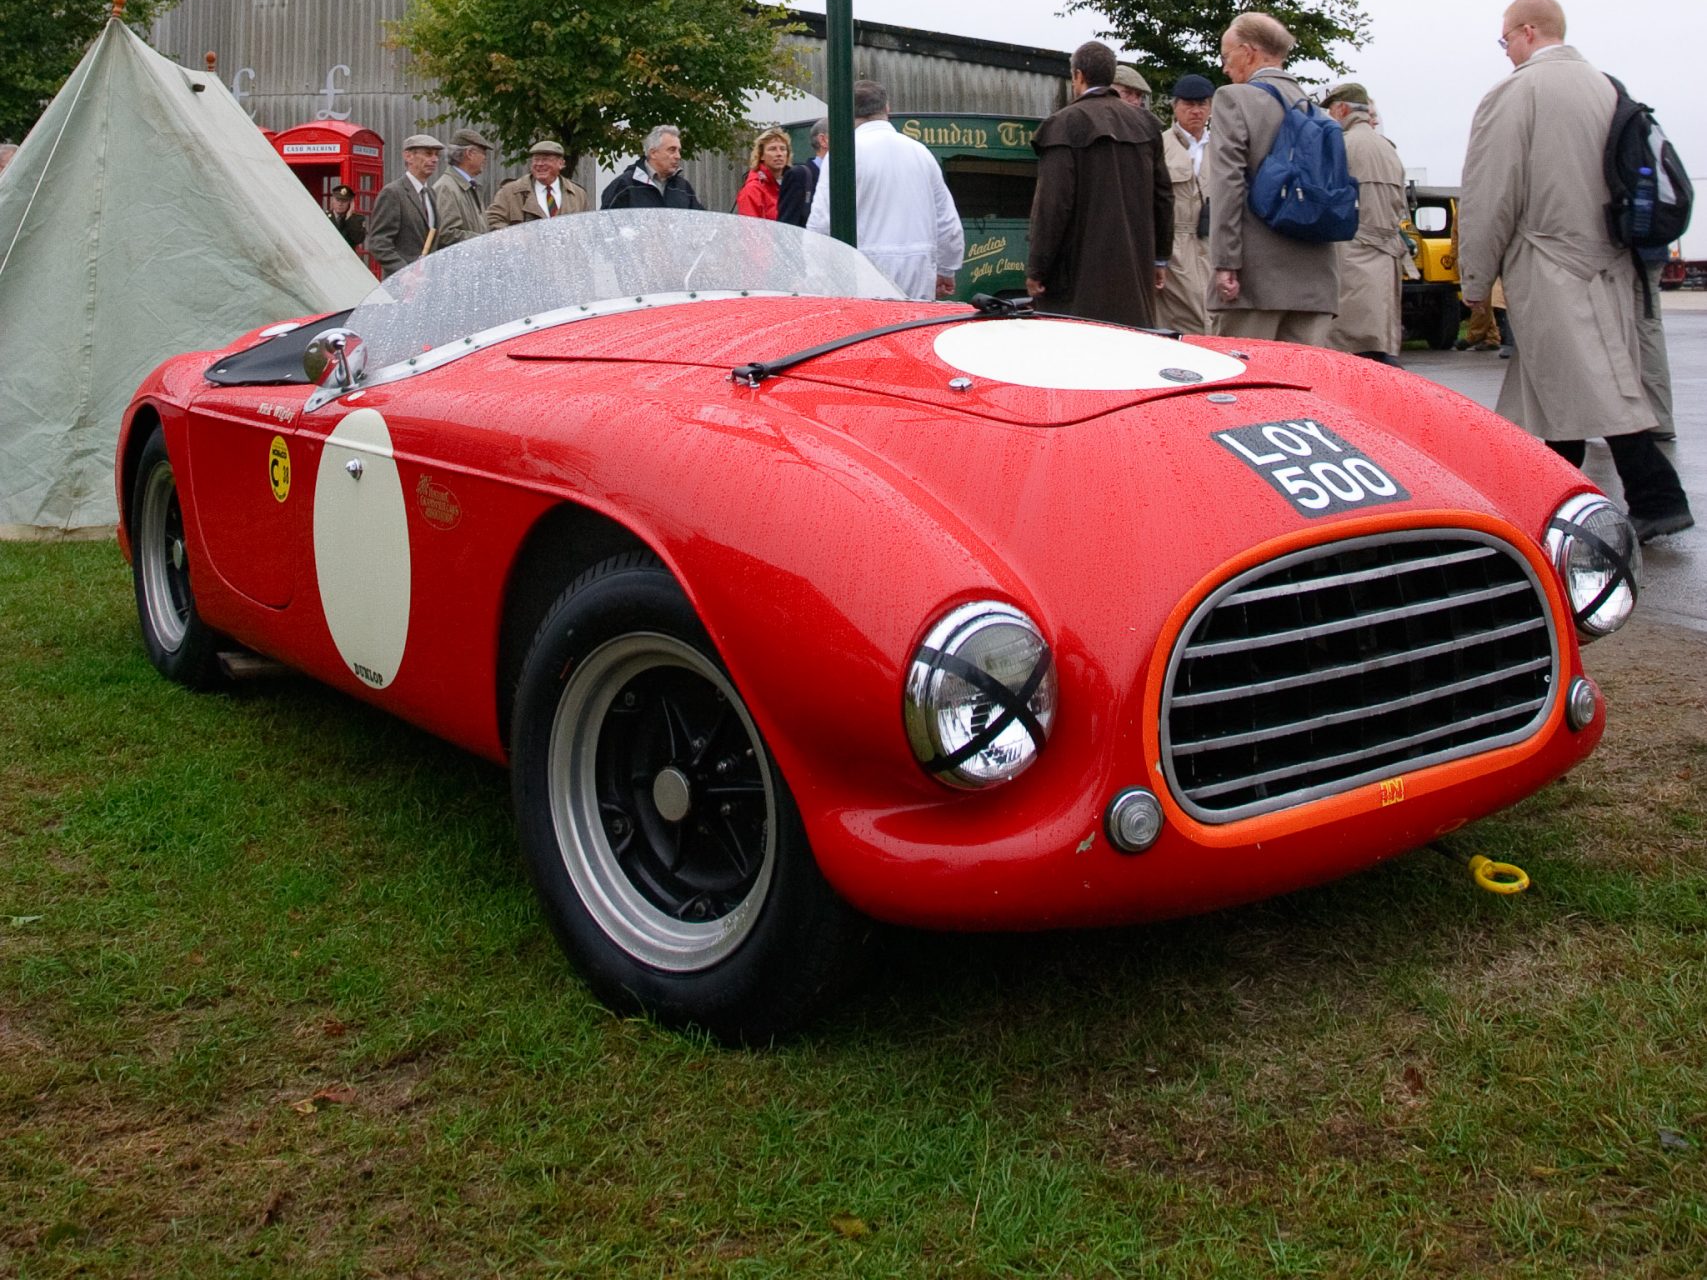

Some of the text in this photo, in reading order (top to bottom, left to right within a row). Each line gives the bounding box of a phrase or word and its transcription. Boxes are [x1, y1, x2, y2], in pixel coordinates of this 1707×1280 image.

[902, 119, 989, 149] Sunday
[1218, 421, 1343, 466] LOY
[1271, 457, 1397, 510] 500
[353, 662, 384, 686] DUNLOP
